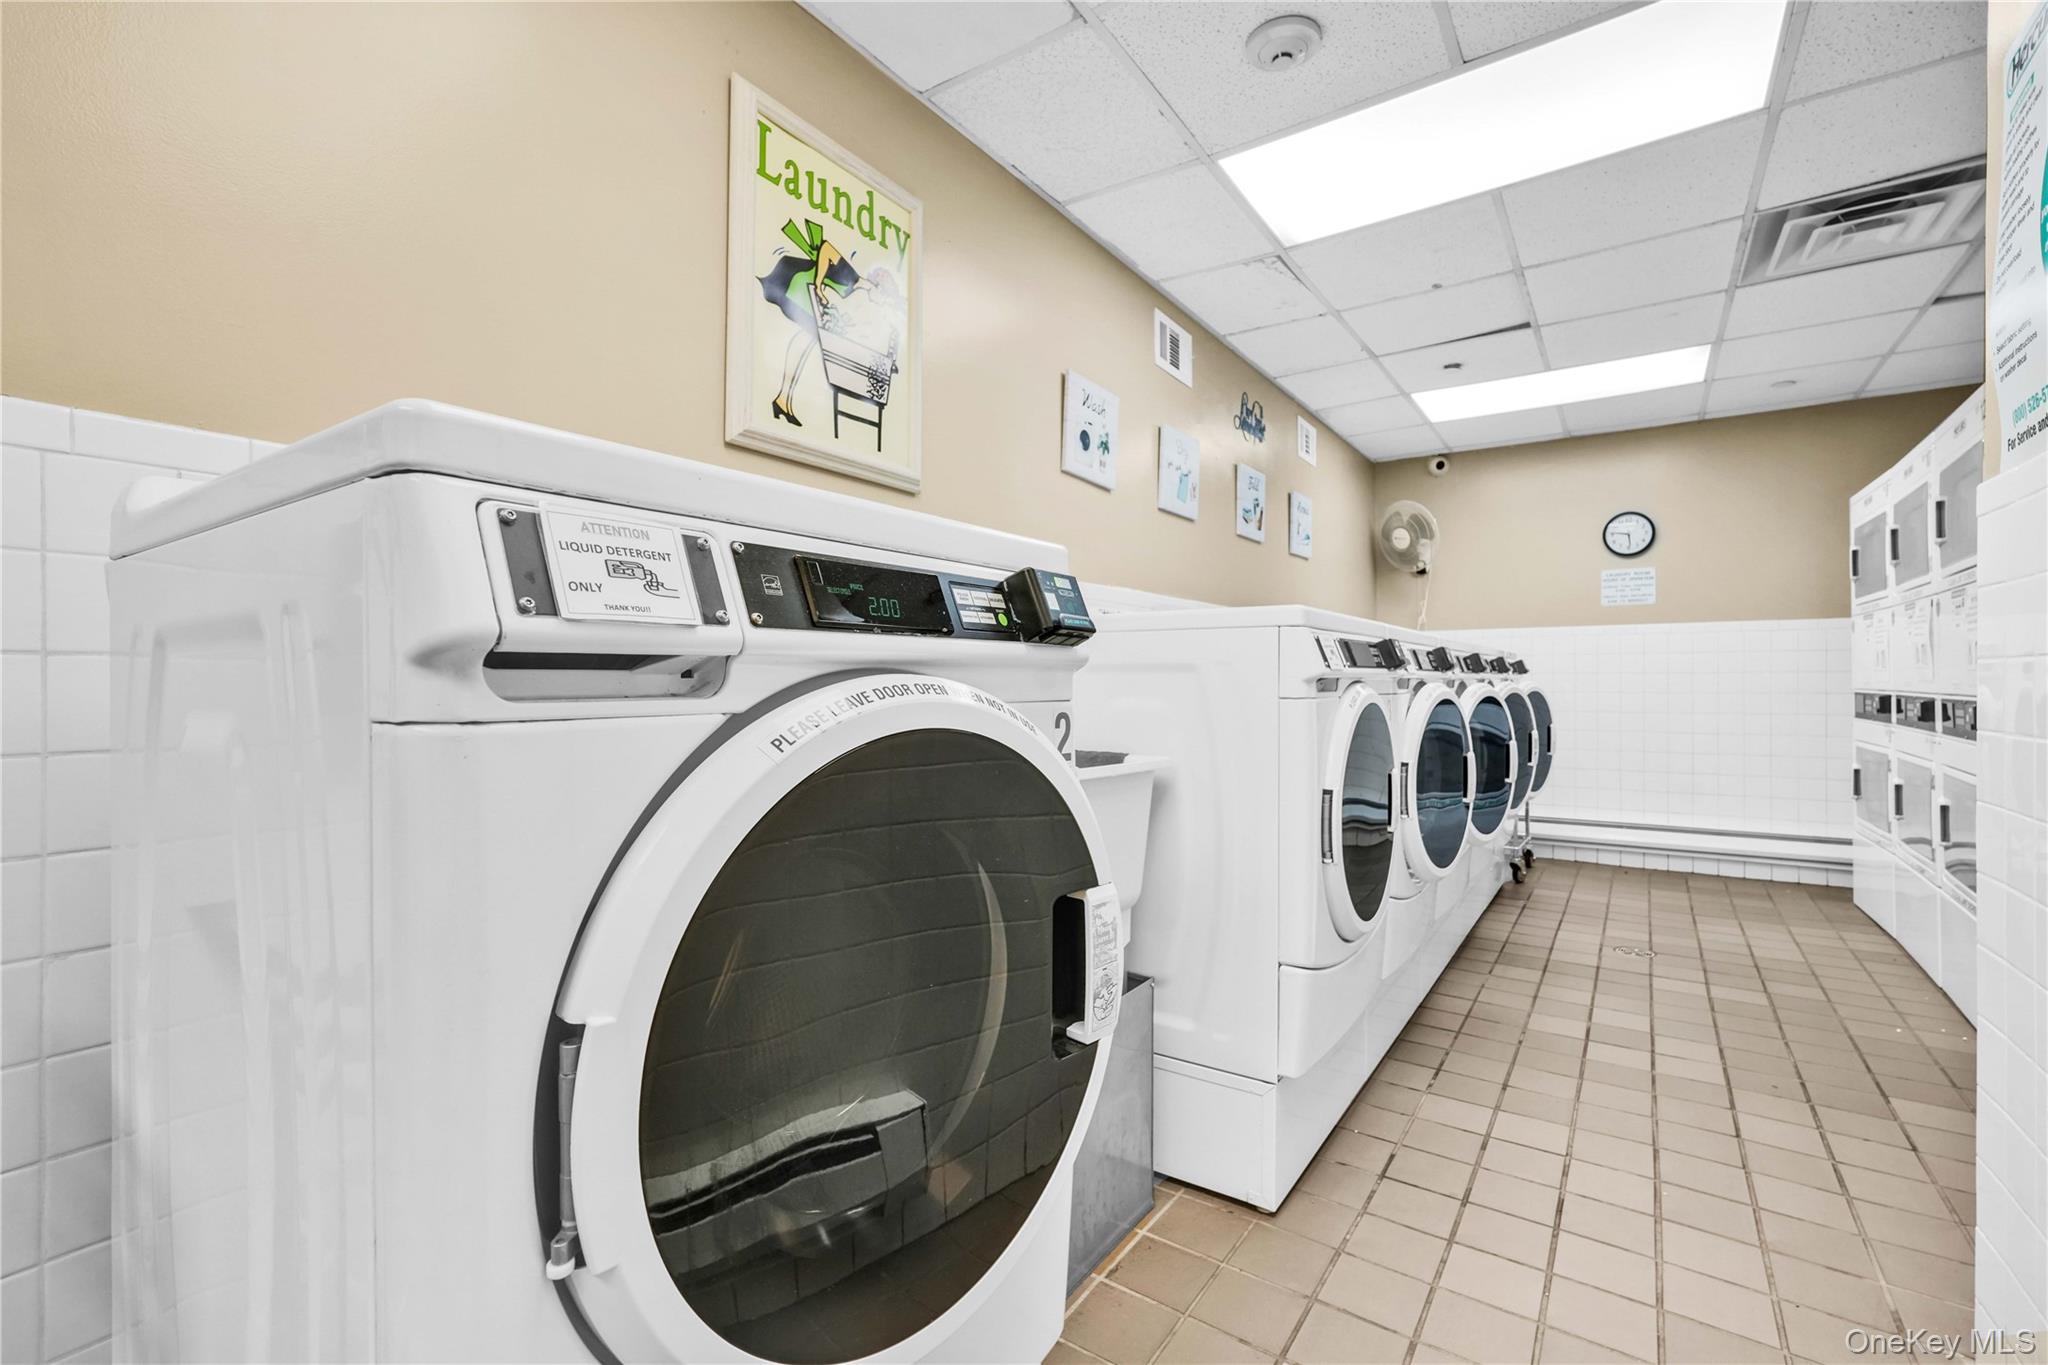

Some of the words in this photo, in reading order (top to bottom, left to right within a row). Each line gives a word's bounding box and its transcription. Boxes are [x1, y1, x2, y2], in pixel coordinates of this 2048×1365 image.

[757, 119, 911, 269] Laundry
[2007, 438, 2017, 452] For
[2016, 422, 2037, 446] Service
[581, 521, 651, 541] ATTENTION
[559, 540, 603, 555] LIQUID
[606, 545, 673, 562] DETERGENT
[568, 581, 603, 593] ONLY
[604, 603, 629, 613] THANK
[868, 596, 900, 618] 2.00
[770, 709, 829, 753] PLEASE
[826, 691, 874, 717] LEAVE
[872, 683, 914, 701] DOOR
[914, 683, 949, 696] OPEN
[985, 697, 1006, 713] NOT
[1054, 712, 1072, 761] 2
